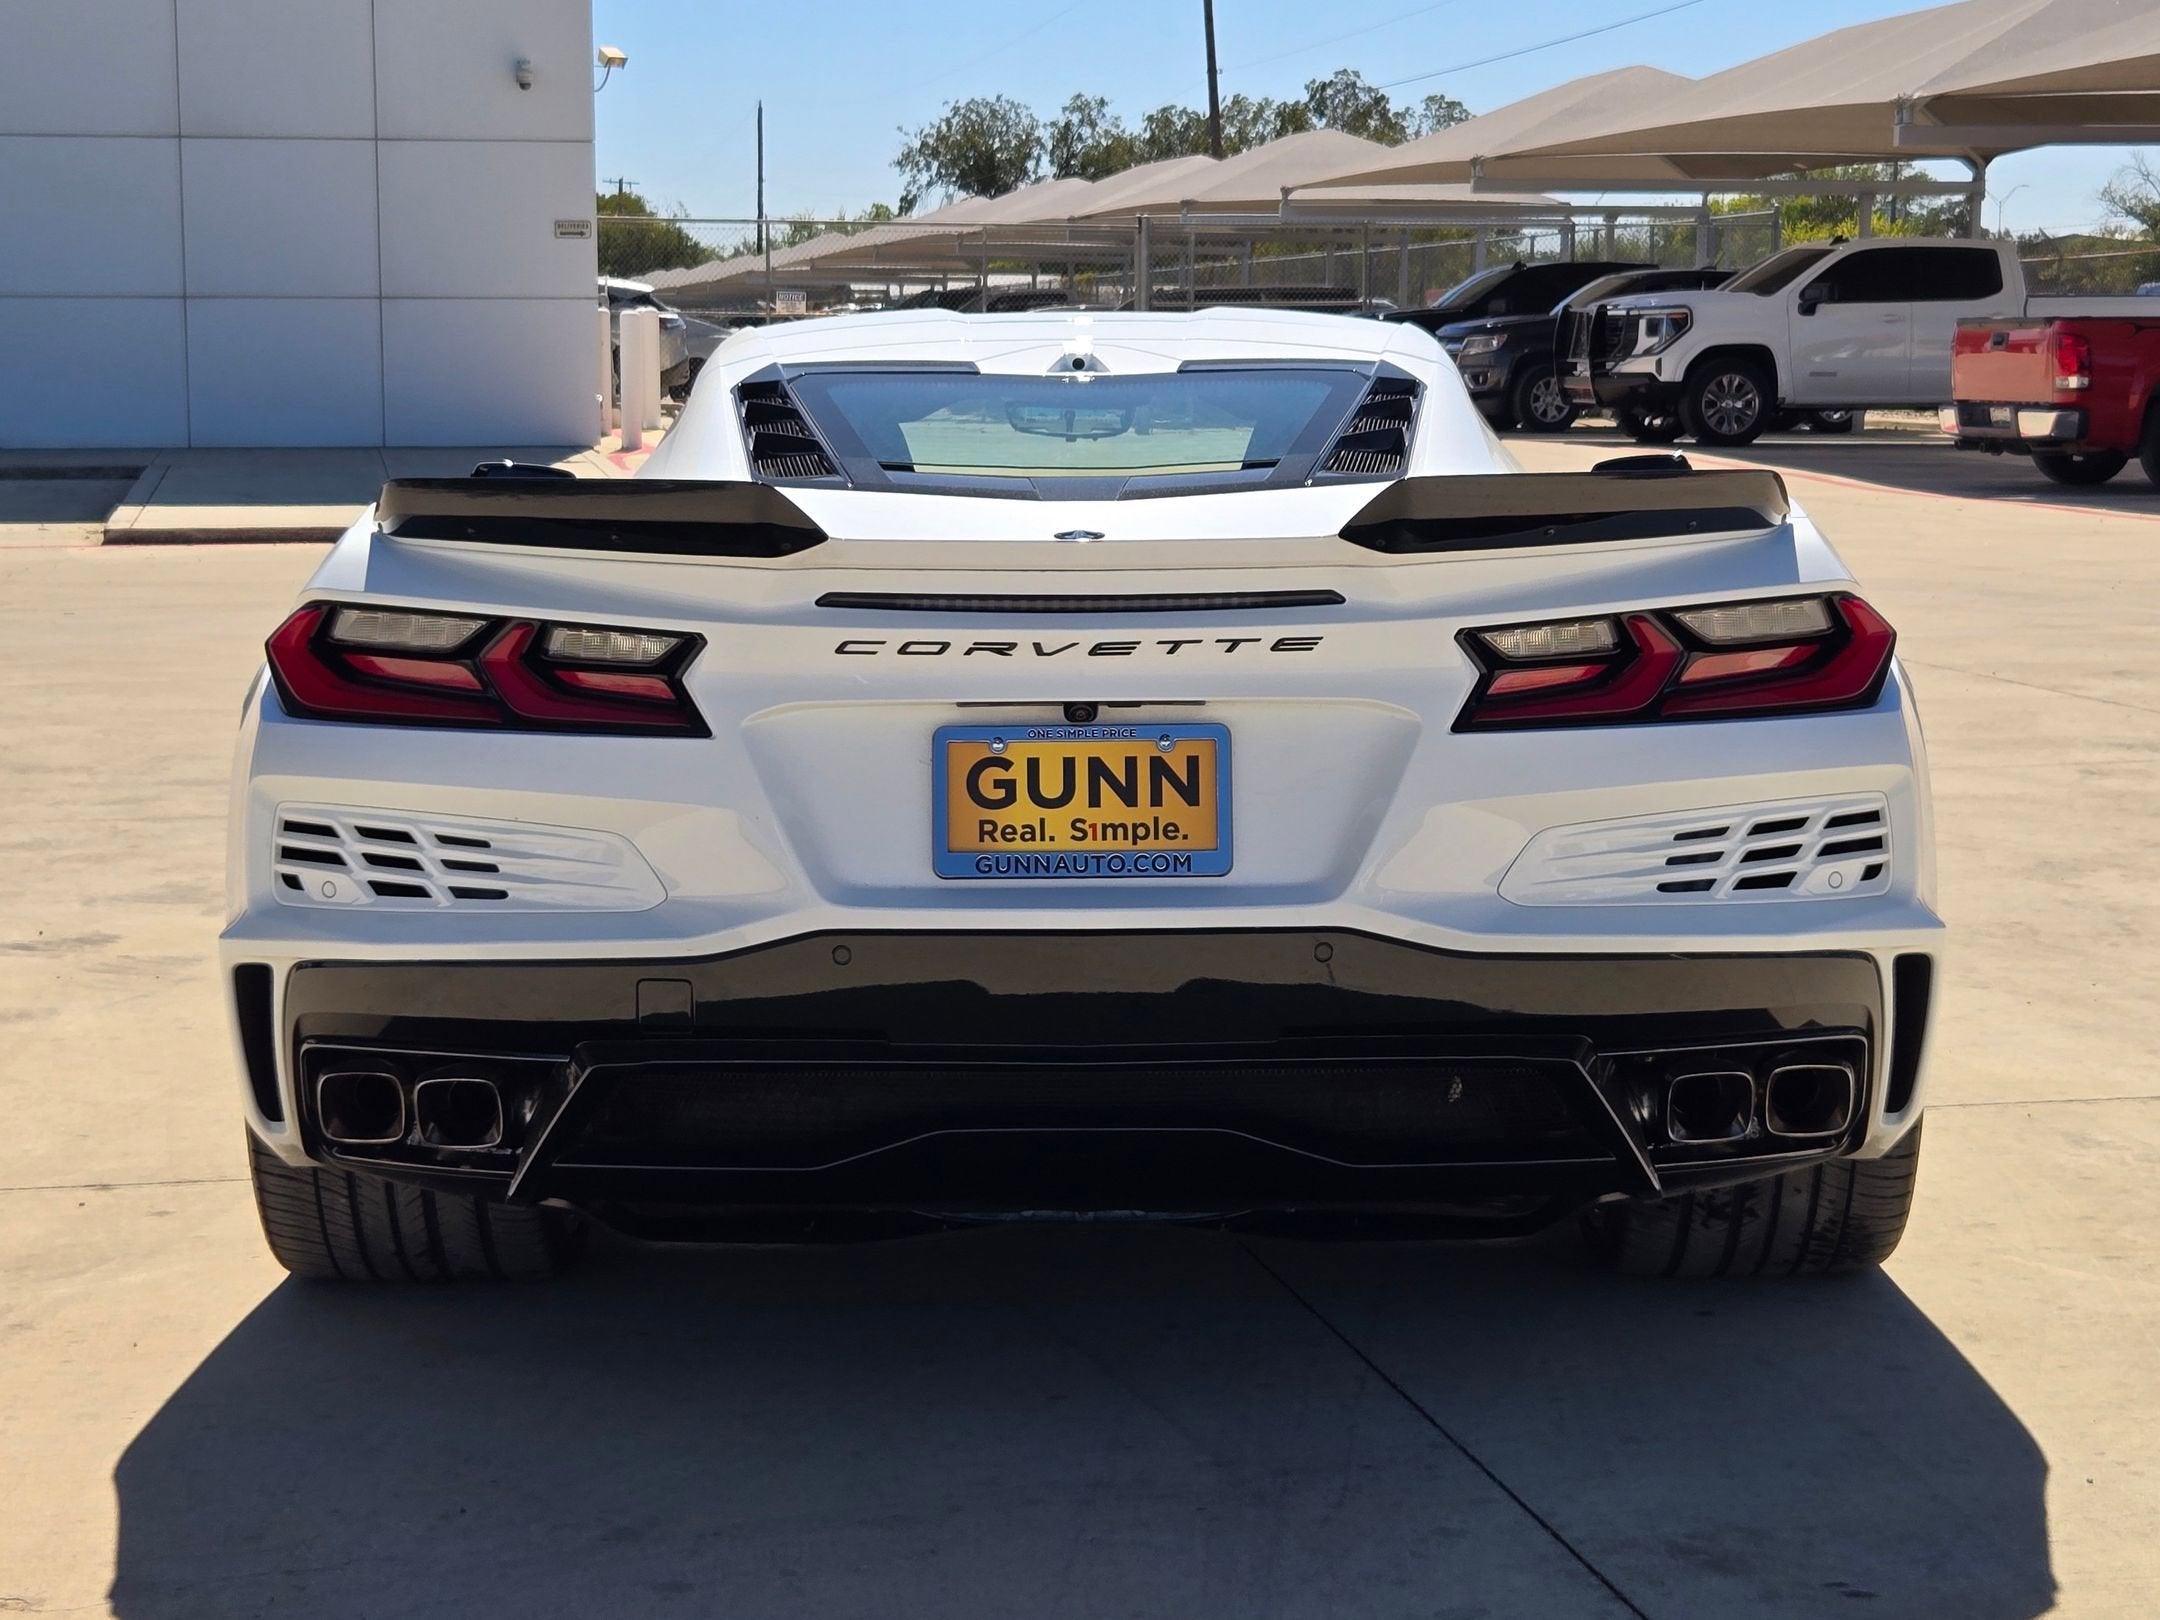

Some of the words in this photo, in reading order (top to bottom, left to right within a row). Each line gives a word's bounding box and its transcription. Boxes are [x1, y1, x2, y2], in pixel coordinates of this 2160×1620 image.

[778, 293, 804, 301] NOTICE
[834, 636, 1325, 657] CORVETTE
[1027, 728, 1053, 738] ONE
[1056, 728, 1099, 738] SIMPLE
[1102, 728, 1137, 738] PRICE
[966, 755, 1200, 810] GUNN
[978, 817, 1055, 843] Real.
[975, 853, 1192, 875] GUNNAUTO.COM
